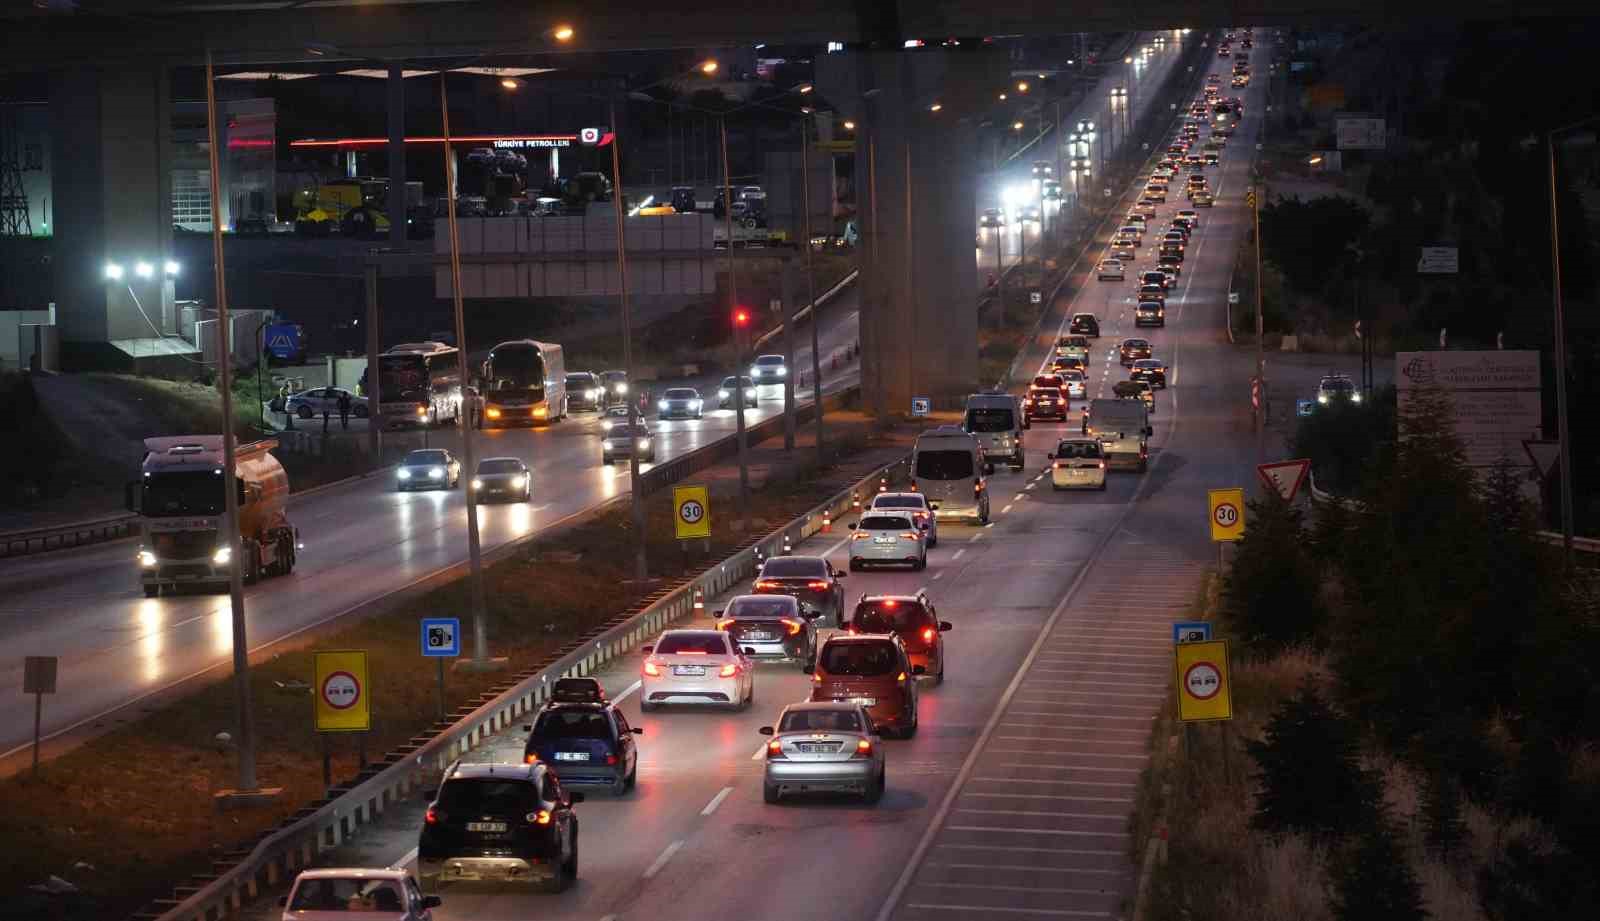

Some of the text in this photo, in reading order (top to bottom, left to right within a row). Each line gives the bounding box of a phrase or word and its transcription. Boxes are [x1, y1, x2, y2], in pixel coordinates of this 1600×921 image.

[494, 139, 524, 148] TÜRKİYE
[684, 505, 700, 518] 30
[1218, 507, 1235, 521] 30
